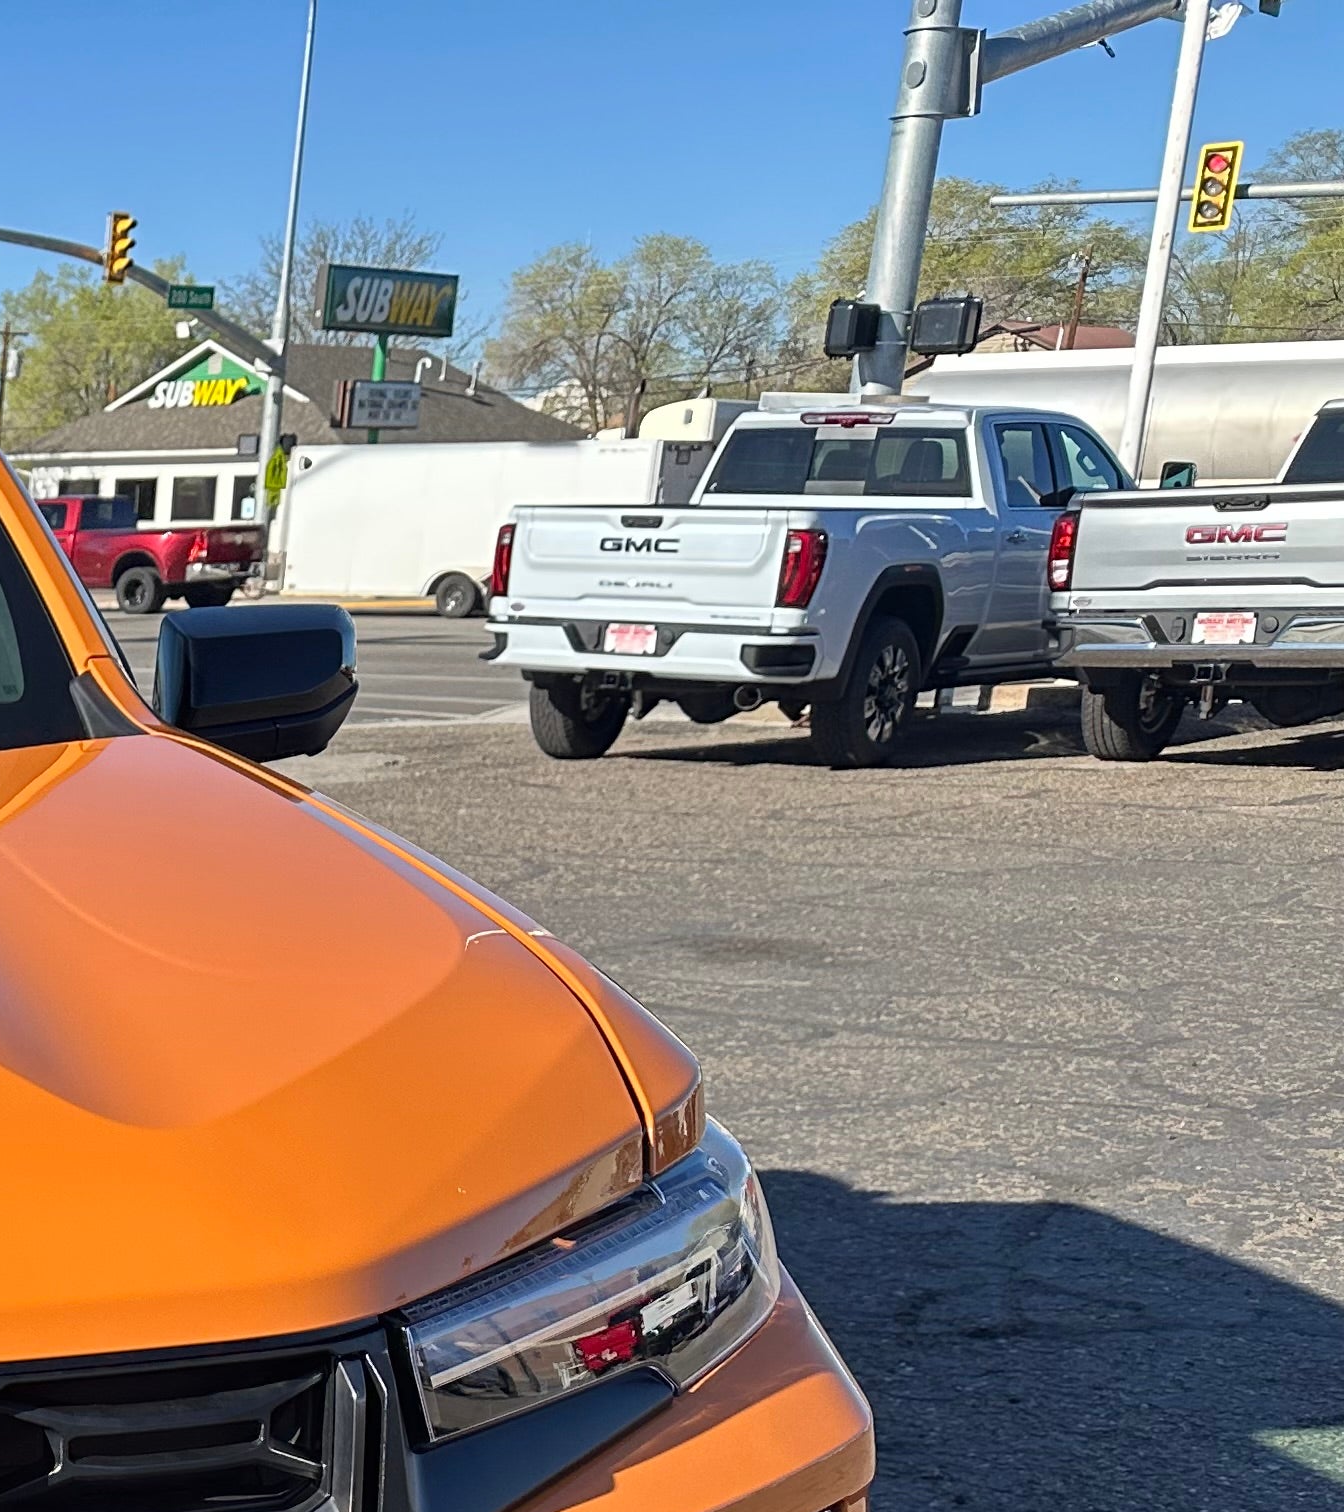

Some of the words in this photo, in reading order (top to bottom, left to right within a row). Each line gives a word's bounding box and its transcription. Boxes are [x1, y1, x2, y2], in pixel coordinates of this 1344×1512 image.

[336, 276, 452, 327] SUBWAY
[148, 376, 248, 409] SUBWAY
[599, 537, 681, 553] GMC
[1185, 521, 1289, 544] GMC
